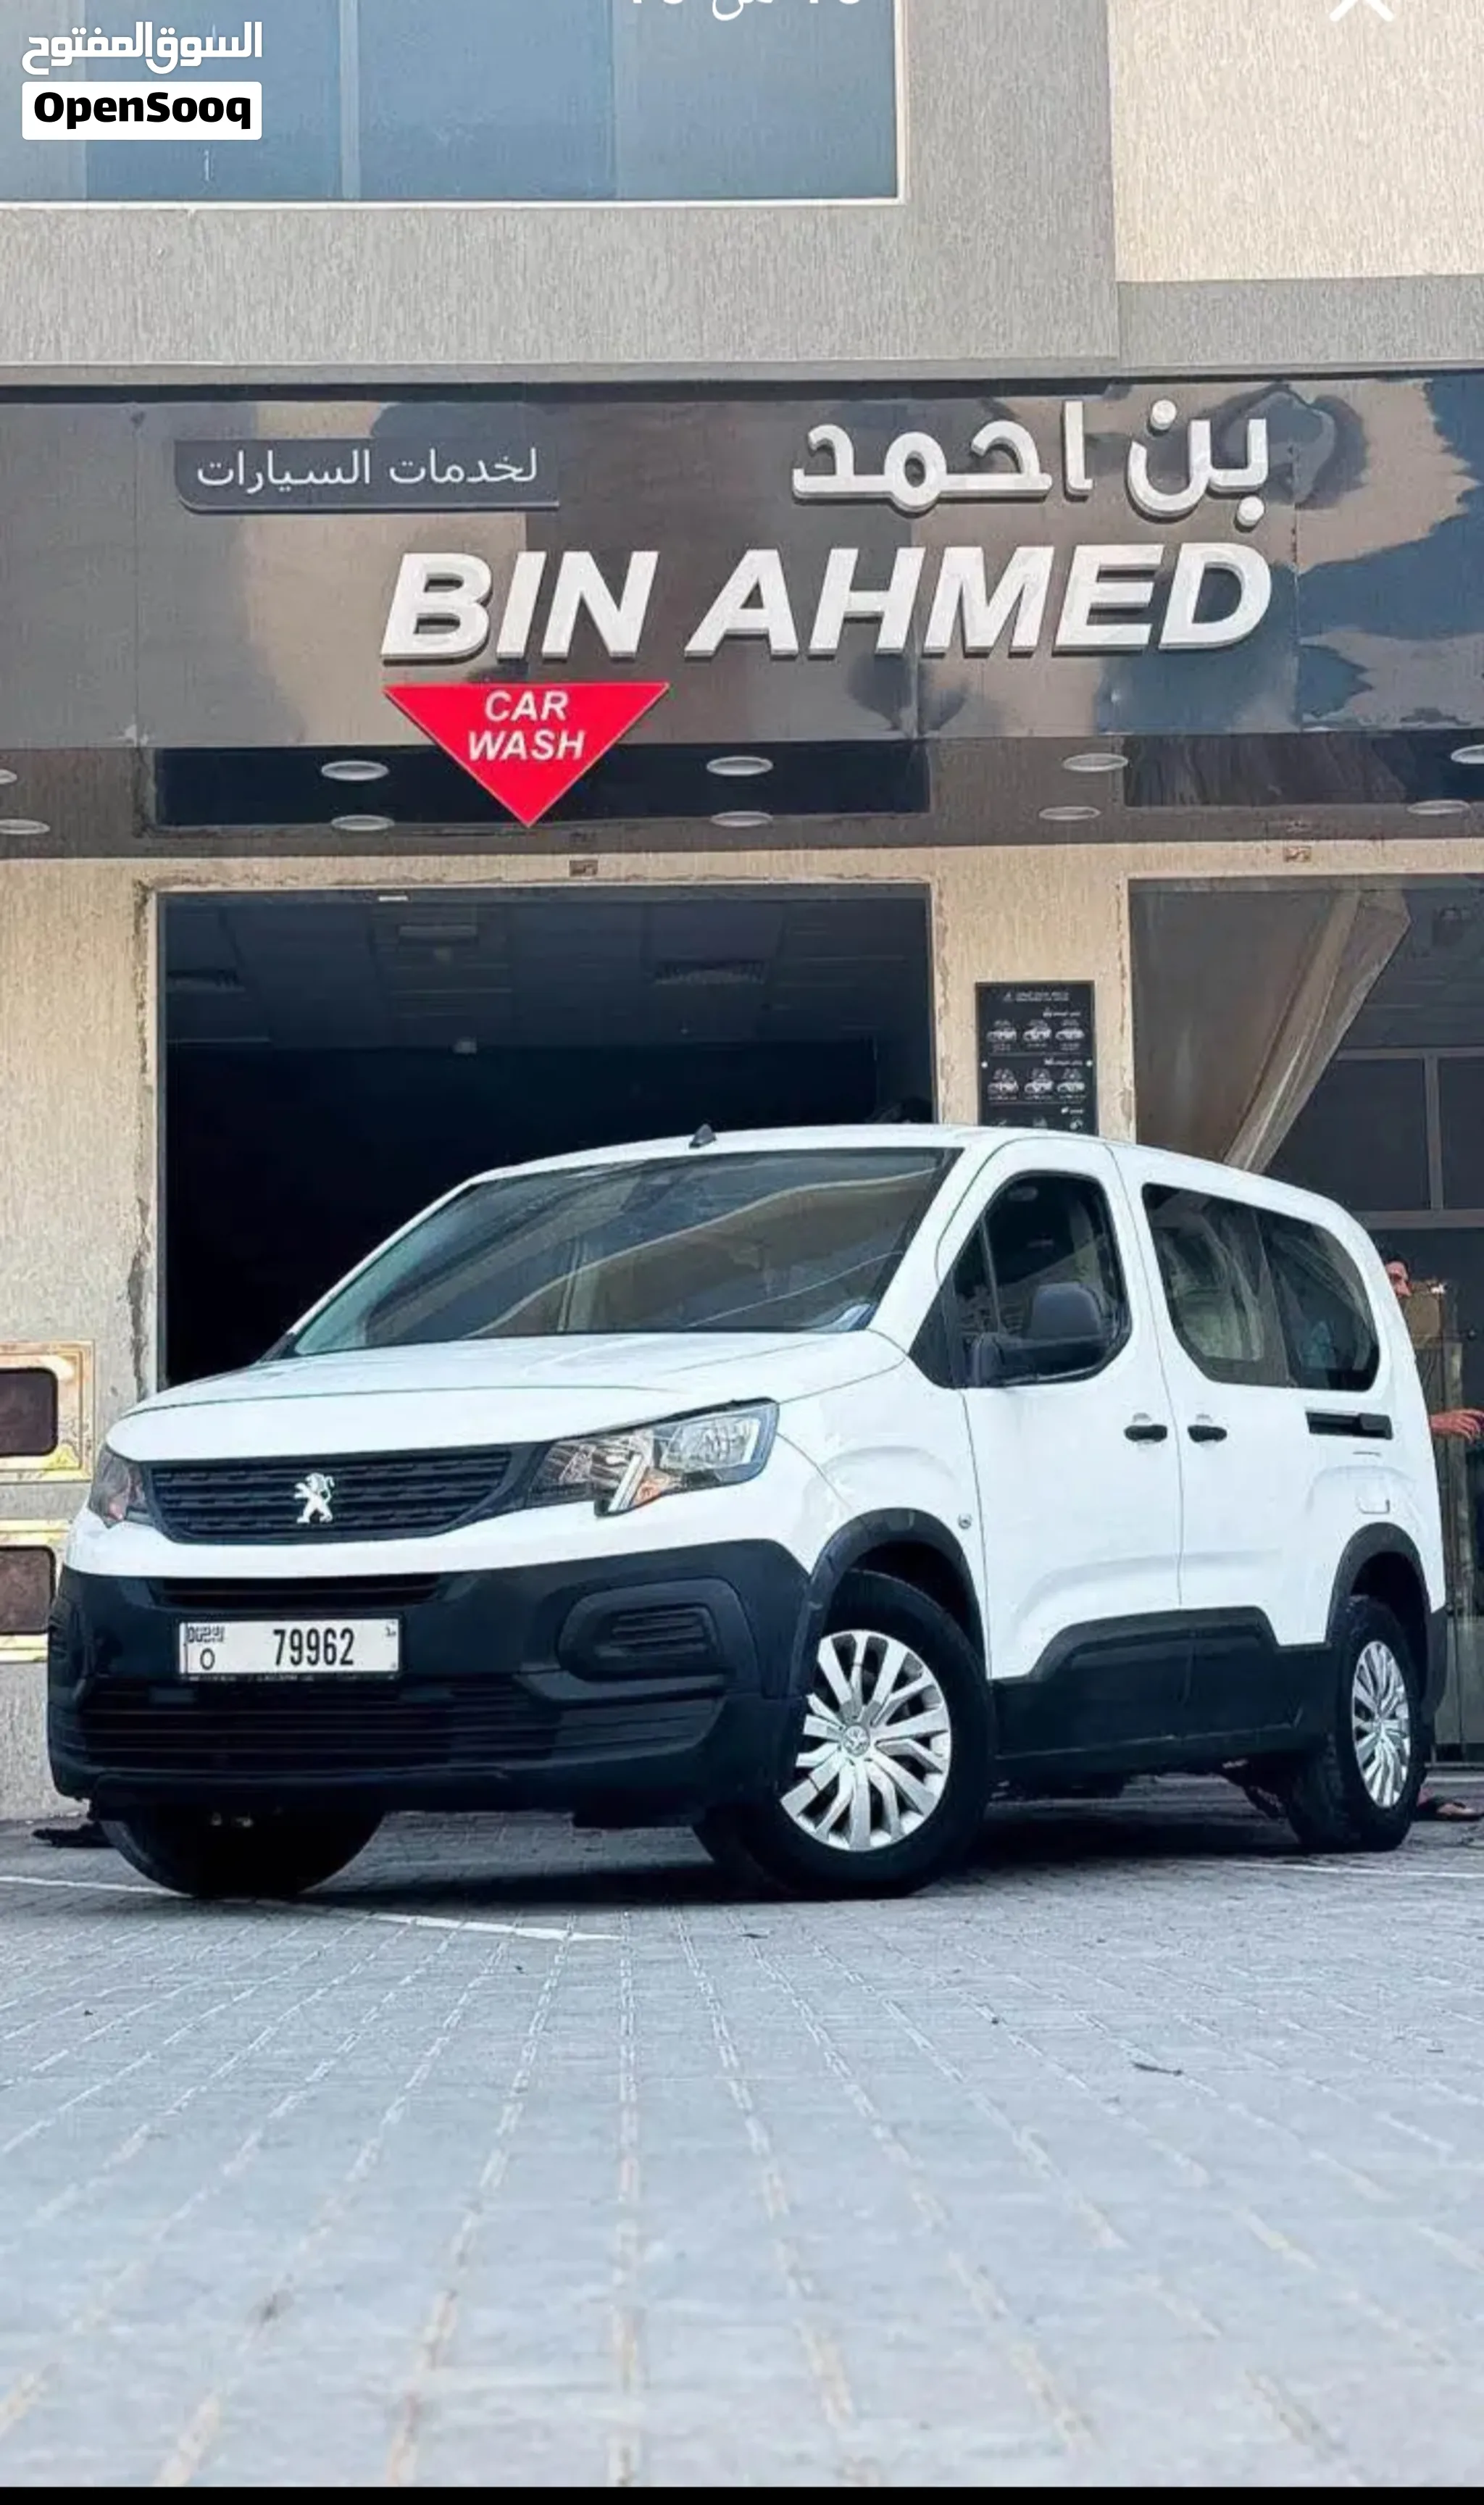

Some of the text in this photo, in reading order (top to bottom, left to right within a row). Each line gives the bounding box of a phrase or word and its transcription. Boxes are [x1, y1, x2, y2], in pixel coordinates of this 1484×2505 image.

[197, 448, 537, 493] لخدمات السيارات
[792, 400, 1268, 525] بن احمد
[382, 542, 1272, 659] BIN AHMED
[484, 689, 568, 722] CAR
[468, 728, 585, 762] WASH
[273, 1627, 354, 1666] 79962
